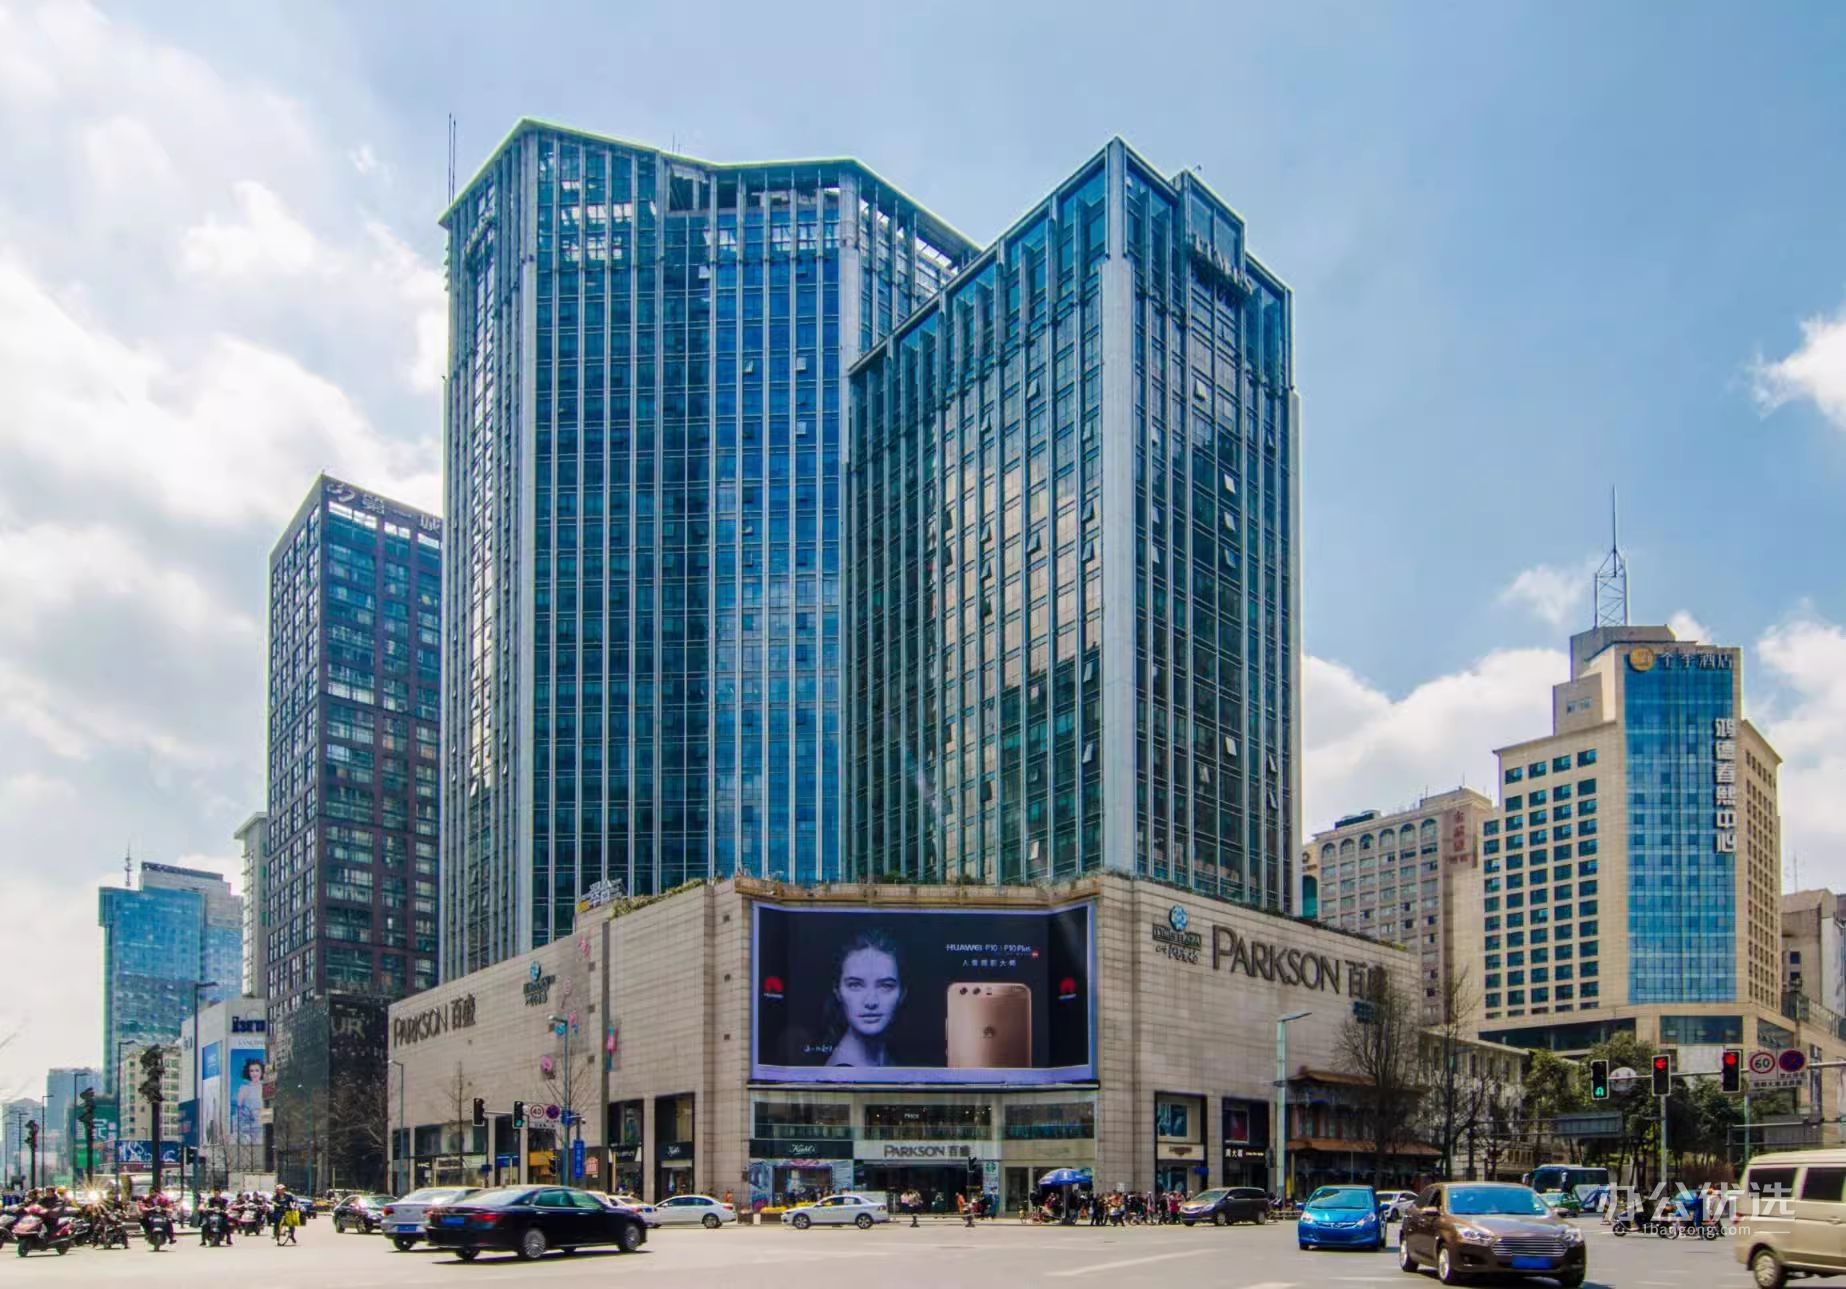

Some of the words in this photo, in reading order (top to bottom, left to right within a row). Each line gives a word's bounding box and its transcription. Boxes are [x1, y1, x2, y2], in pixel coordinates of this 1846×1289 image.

[946, 944, 983, 952] HUAWEI
[1212, 925, 1340, 994] PARKSON
[394, 1004, 448, 1048] PARKSON
[1755, 1058, 1770, 1069] 60
[884, 1144, 945, 1157] PARKSON
